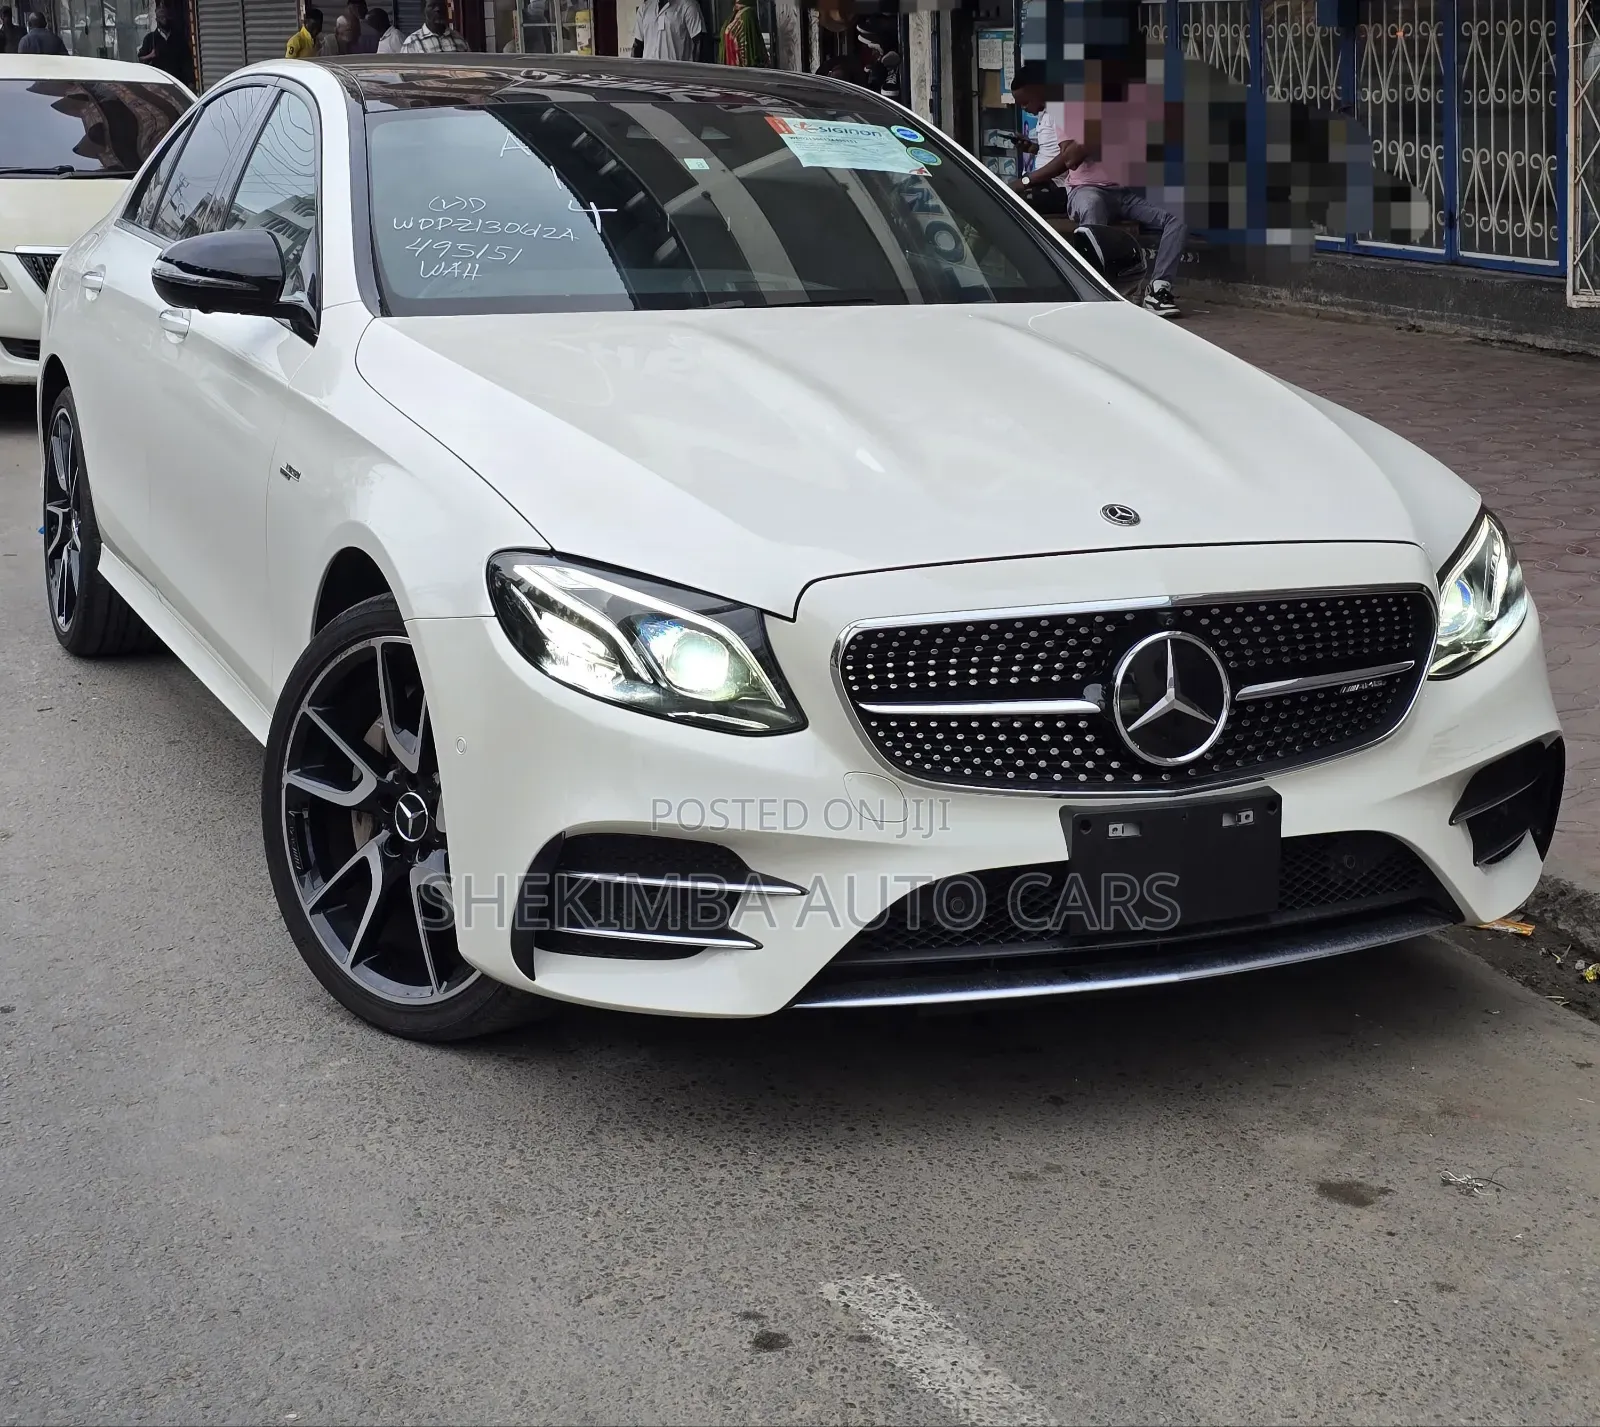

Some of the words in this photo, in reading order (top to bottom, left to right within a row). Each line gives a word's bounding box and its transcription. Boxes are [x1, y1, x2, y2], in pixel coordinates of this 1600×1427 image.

[289, 47, 294, 55] 3
[500, 131, 531, 157] A
[568, 199, 618, 233] 4
